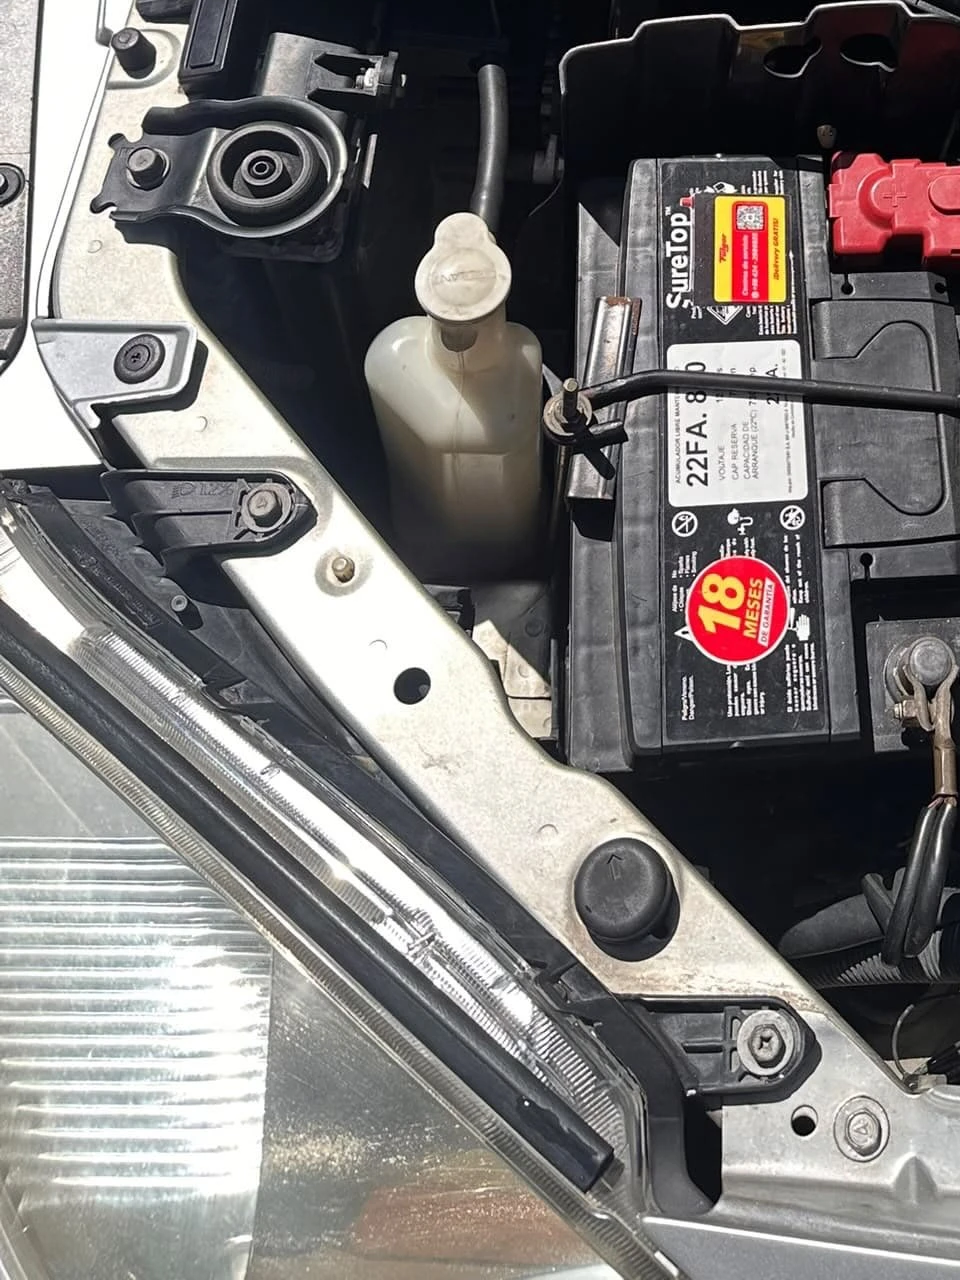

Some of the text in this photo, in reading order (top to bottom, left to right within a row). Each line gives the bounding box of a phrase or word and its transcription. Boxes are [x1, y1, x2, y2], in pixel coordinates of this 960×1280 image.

[685, 362, 708, 487] 22FA. 80
[742, 422, 751, 479] CAPACIDAD DE
[718, 446, 726, 480] VOLTAJE
[751, 434, 759, 479] ARRANQUE
[697, 573, 746, 634] 18
[743, 577, 763, 638] MESES
[760, 583, 774, 643] DE GARANTÍA
